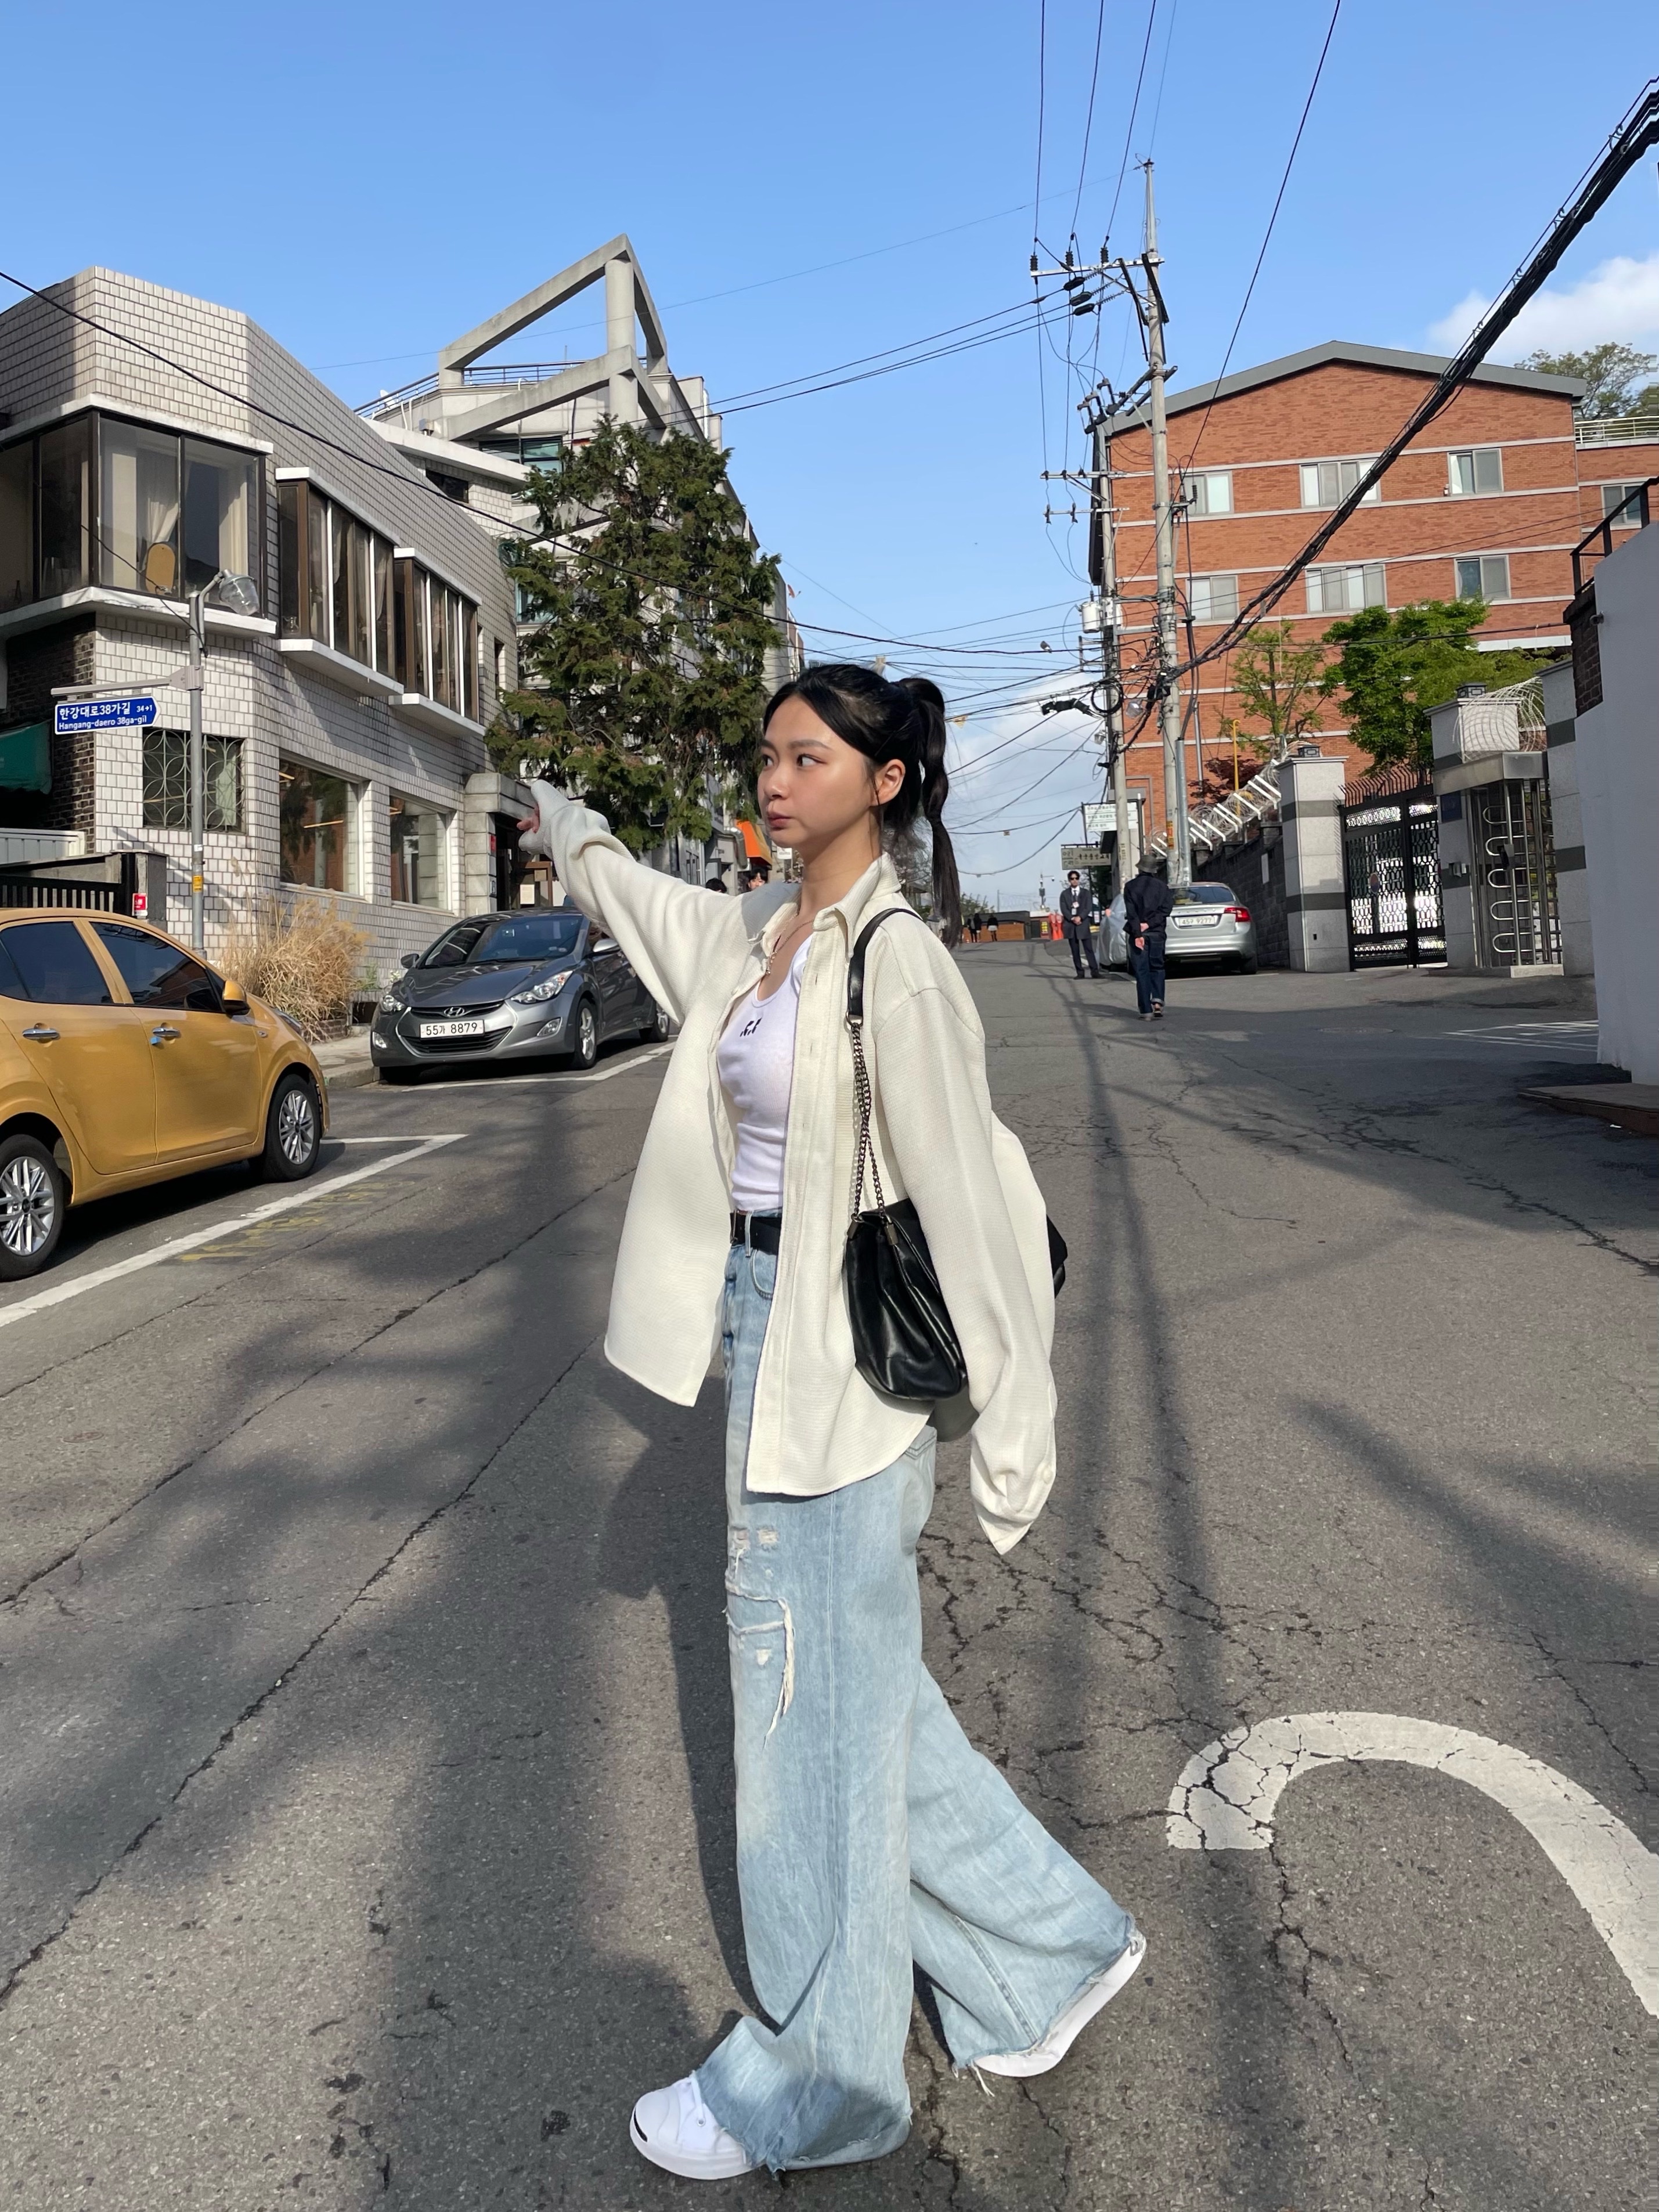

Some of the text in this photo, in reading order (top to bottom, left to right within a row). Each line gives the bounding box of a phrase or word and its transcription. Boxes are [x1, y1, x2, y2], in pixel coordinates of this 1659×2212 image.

[59, 701, 131, 720] 한강대로38가길
[59, 715, 147, 731] Hangang-daero 38ga-gil
[426, 1022, 477, 1035] 55가 8879
